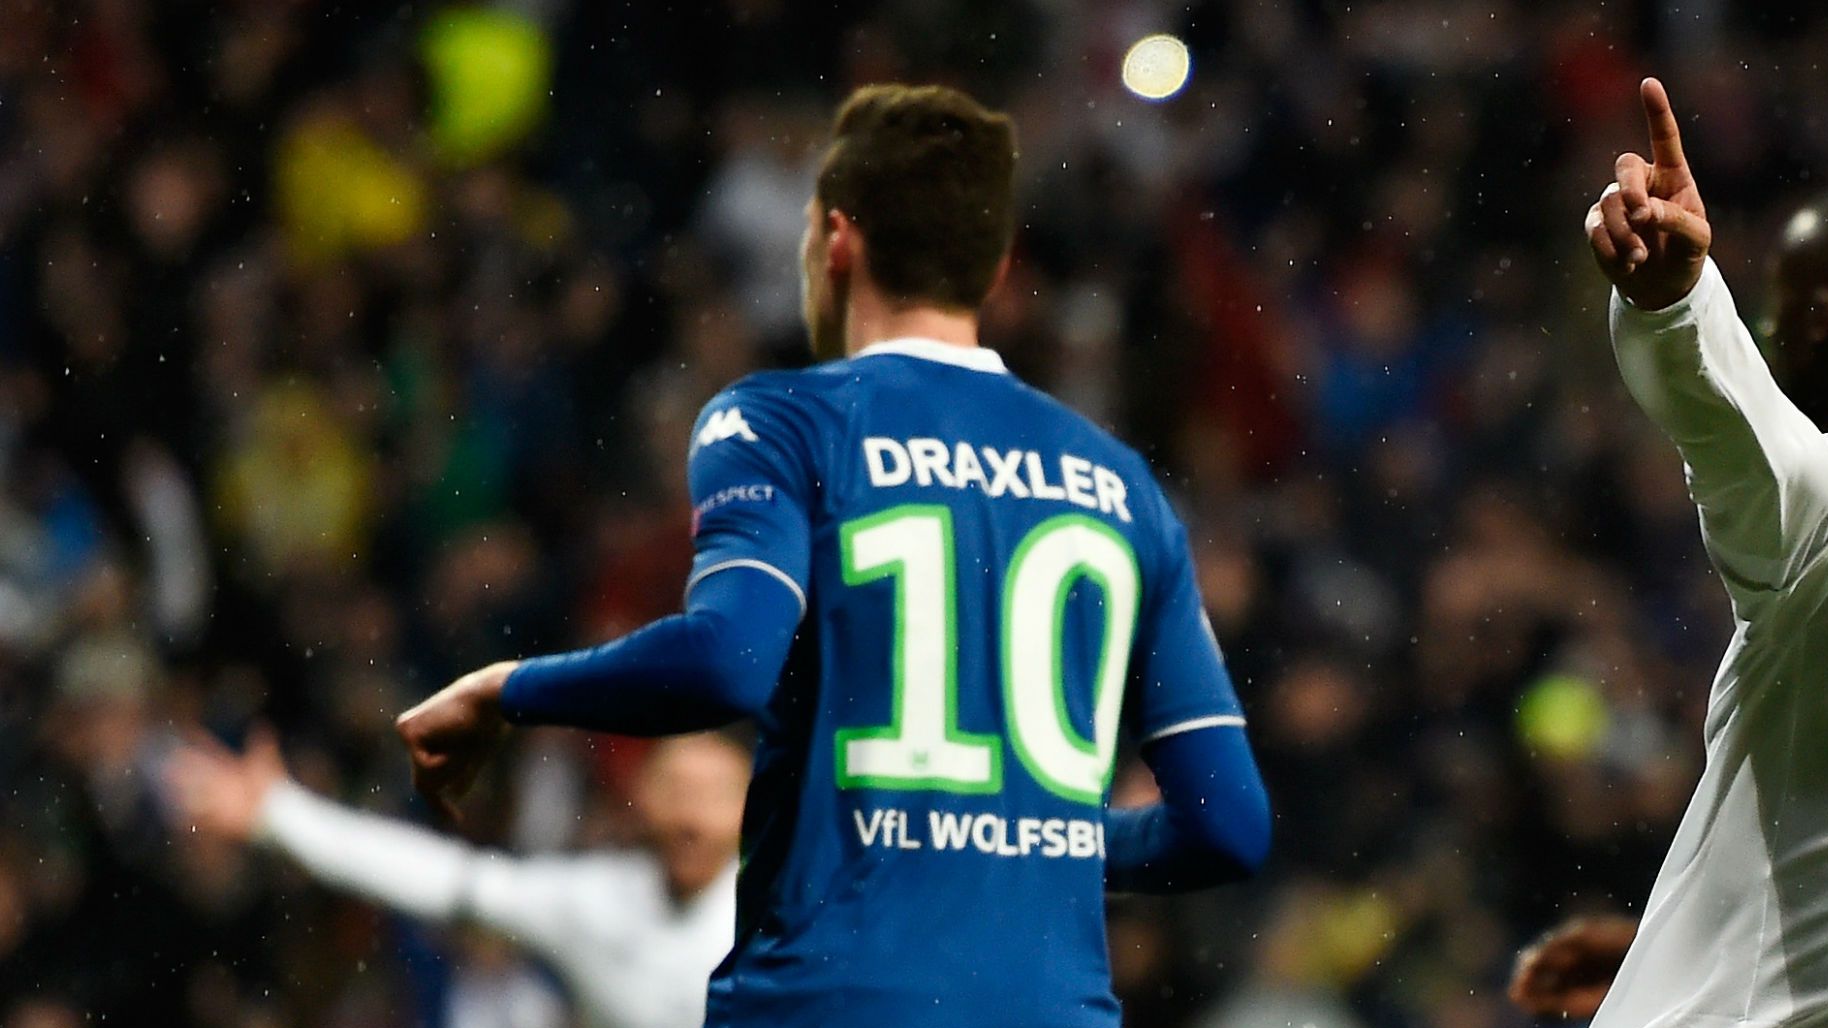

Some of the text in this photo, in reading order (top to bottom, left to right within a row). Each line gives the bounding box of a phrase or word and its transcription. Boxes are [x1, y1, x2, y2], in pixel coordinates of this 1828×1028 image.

[863, 436, 1131, 521] DRAXLER
[834, 503, 1142, 807] 10
[853, 809, 921, 849] VfL
